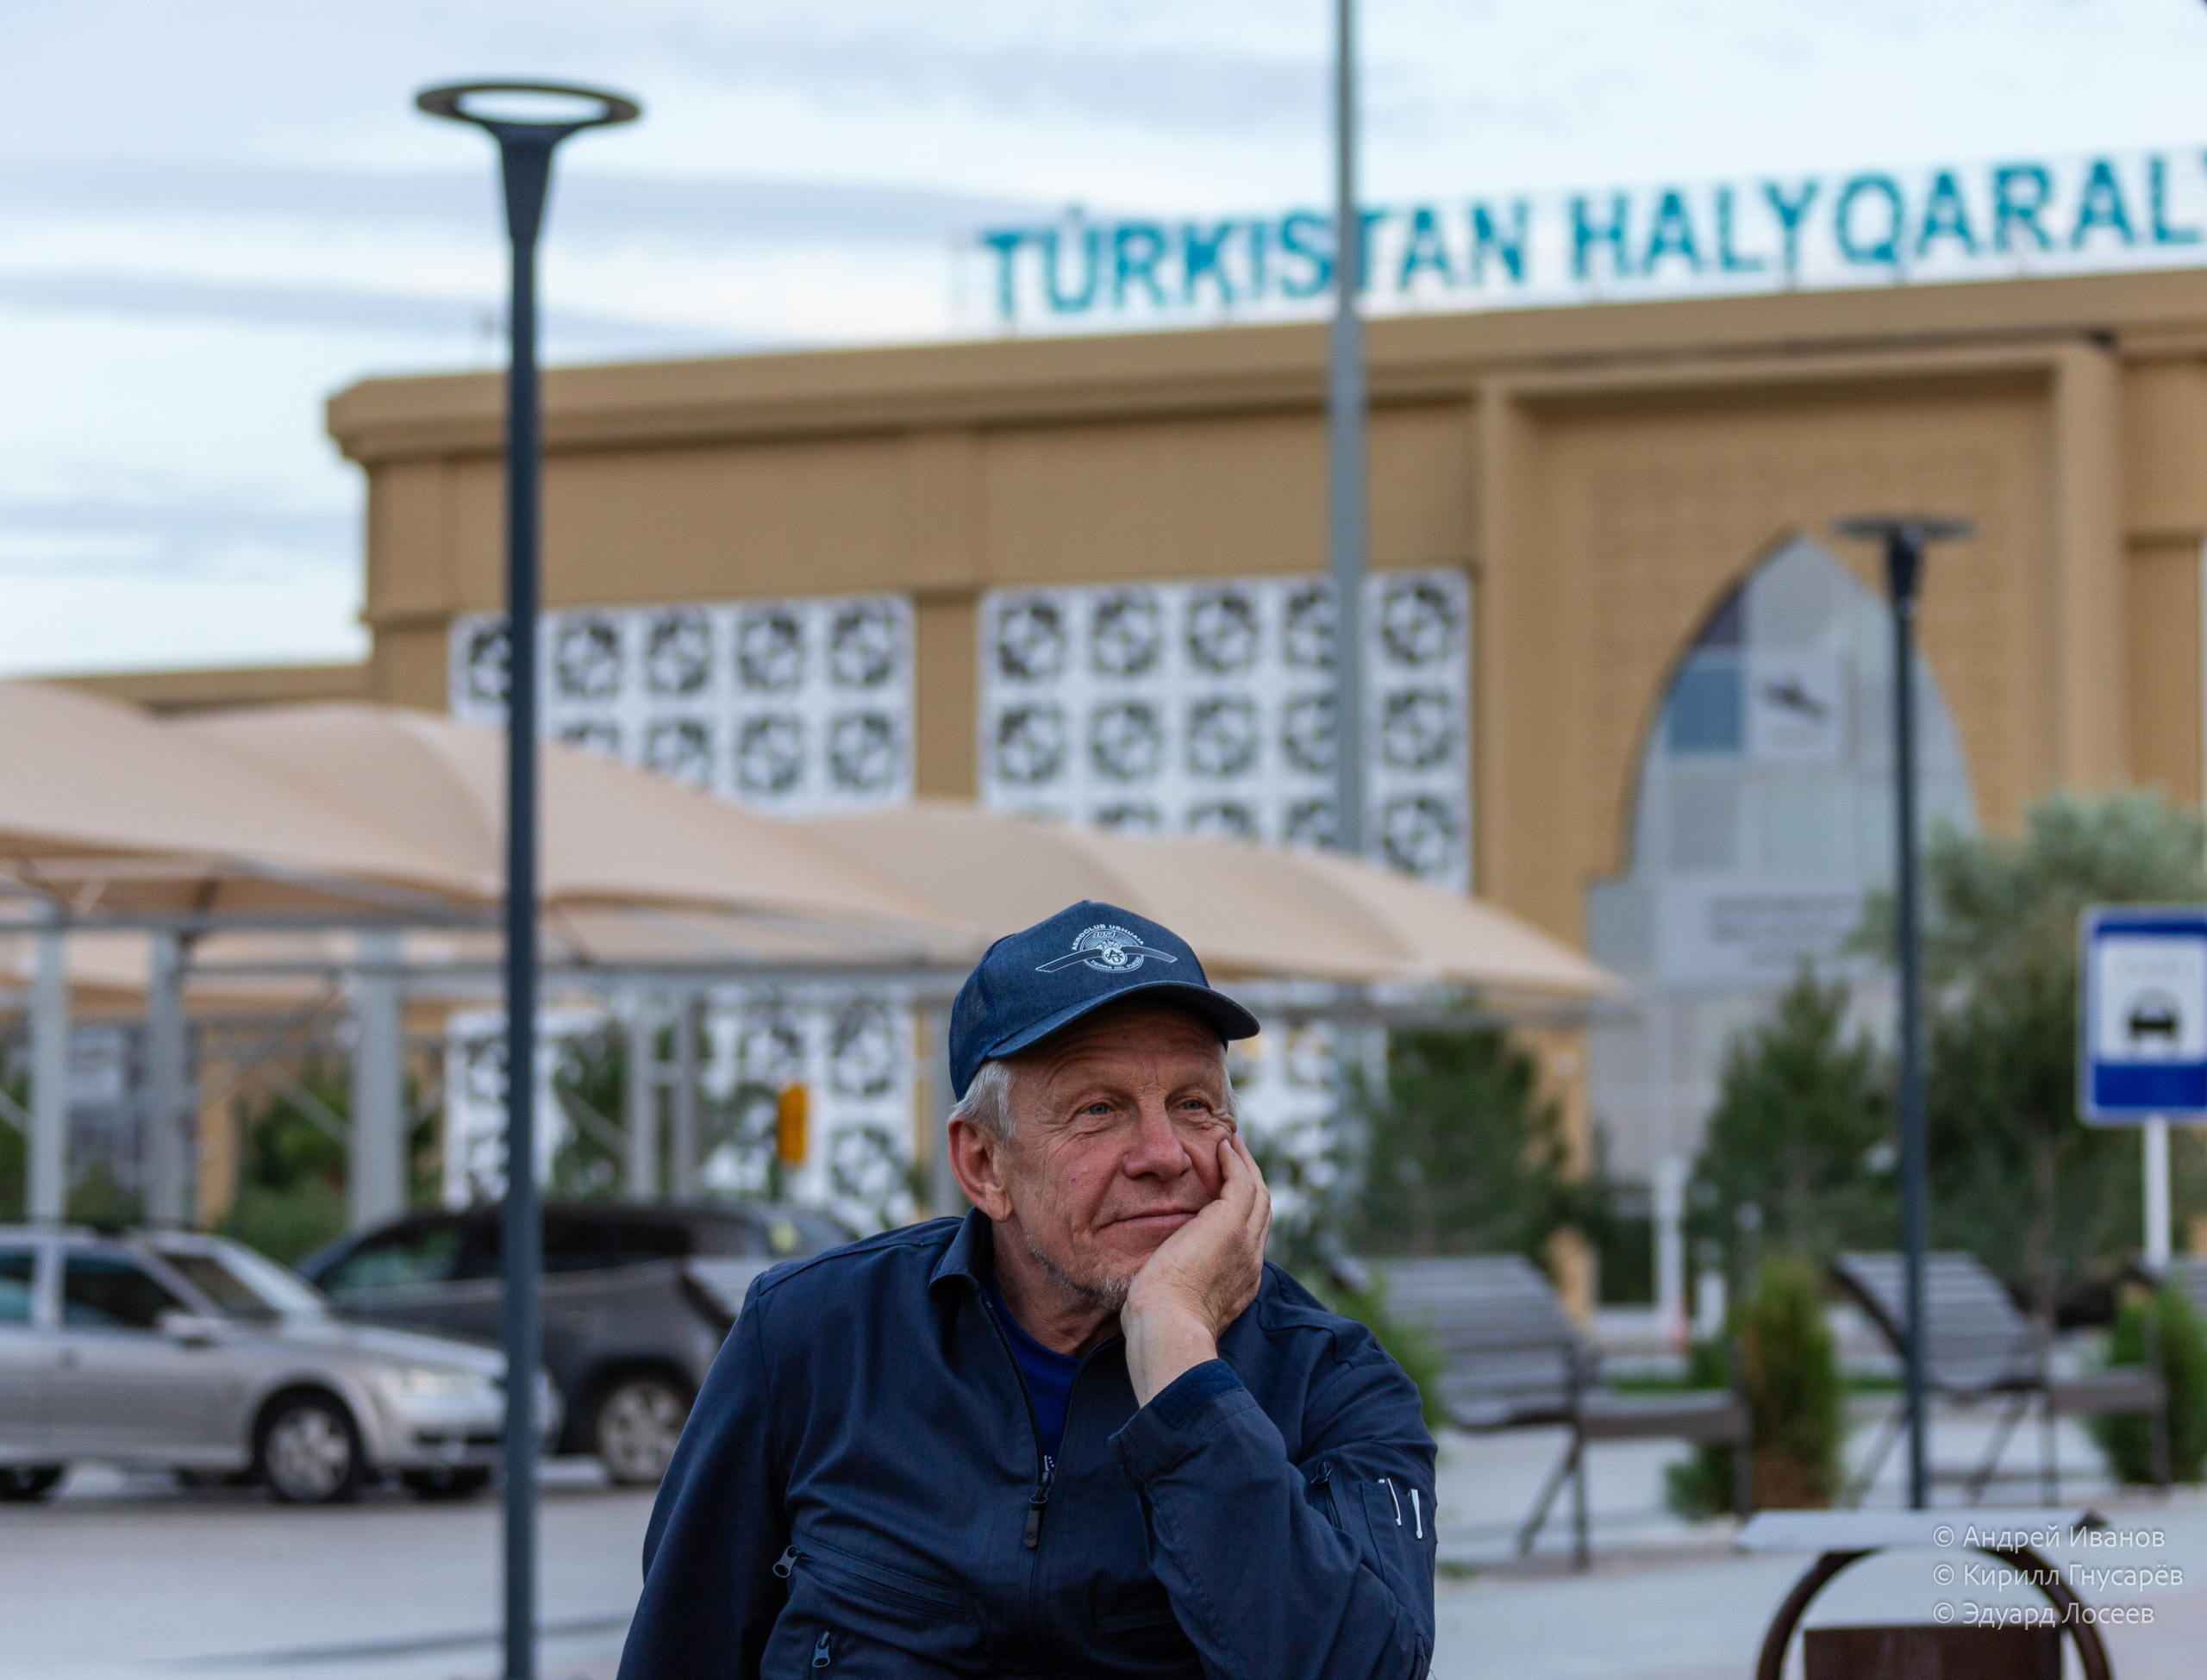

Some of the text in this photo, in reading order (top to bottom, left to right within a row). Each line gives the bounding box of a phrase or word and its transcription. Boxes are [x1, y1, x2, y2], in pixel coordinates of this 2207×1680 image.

[1569, 147, 2207, 280] HALYQARAL
[1072, 923, 1144, 951] AEROCLUB USHUAIA
[1090, 959, 1112, 970] TIERRA
